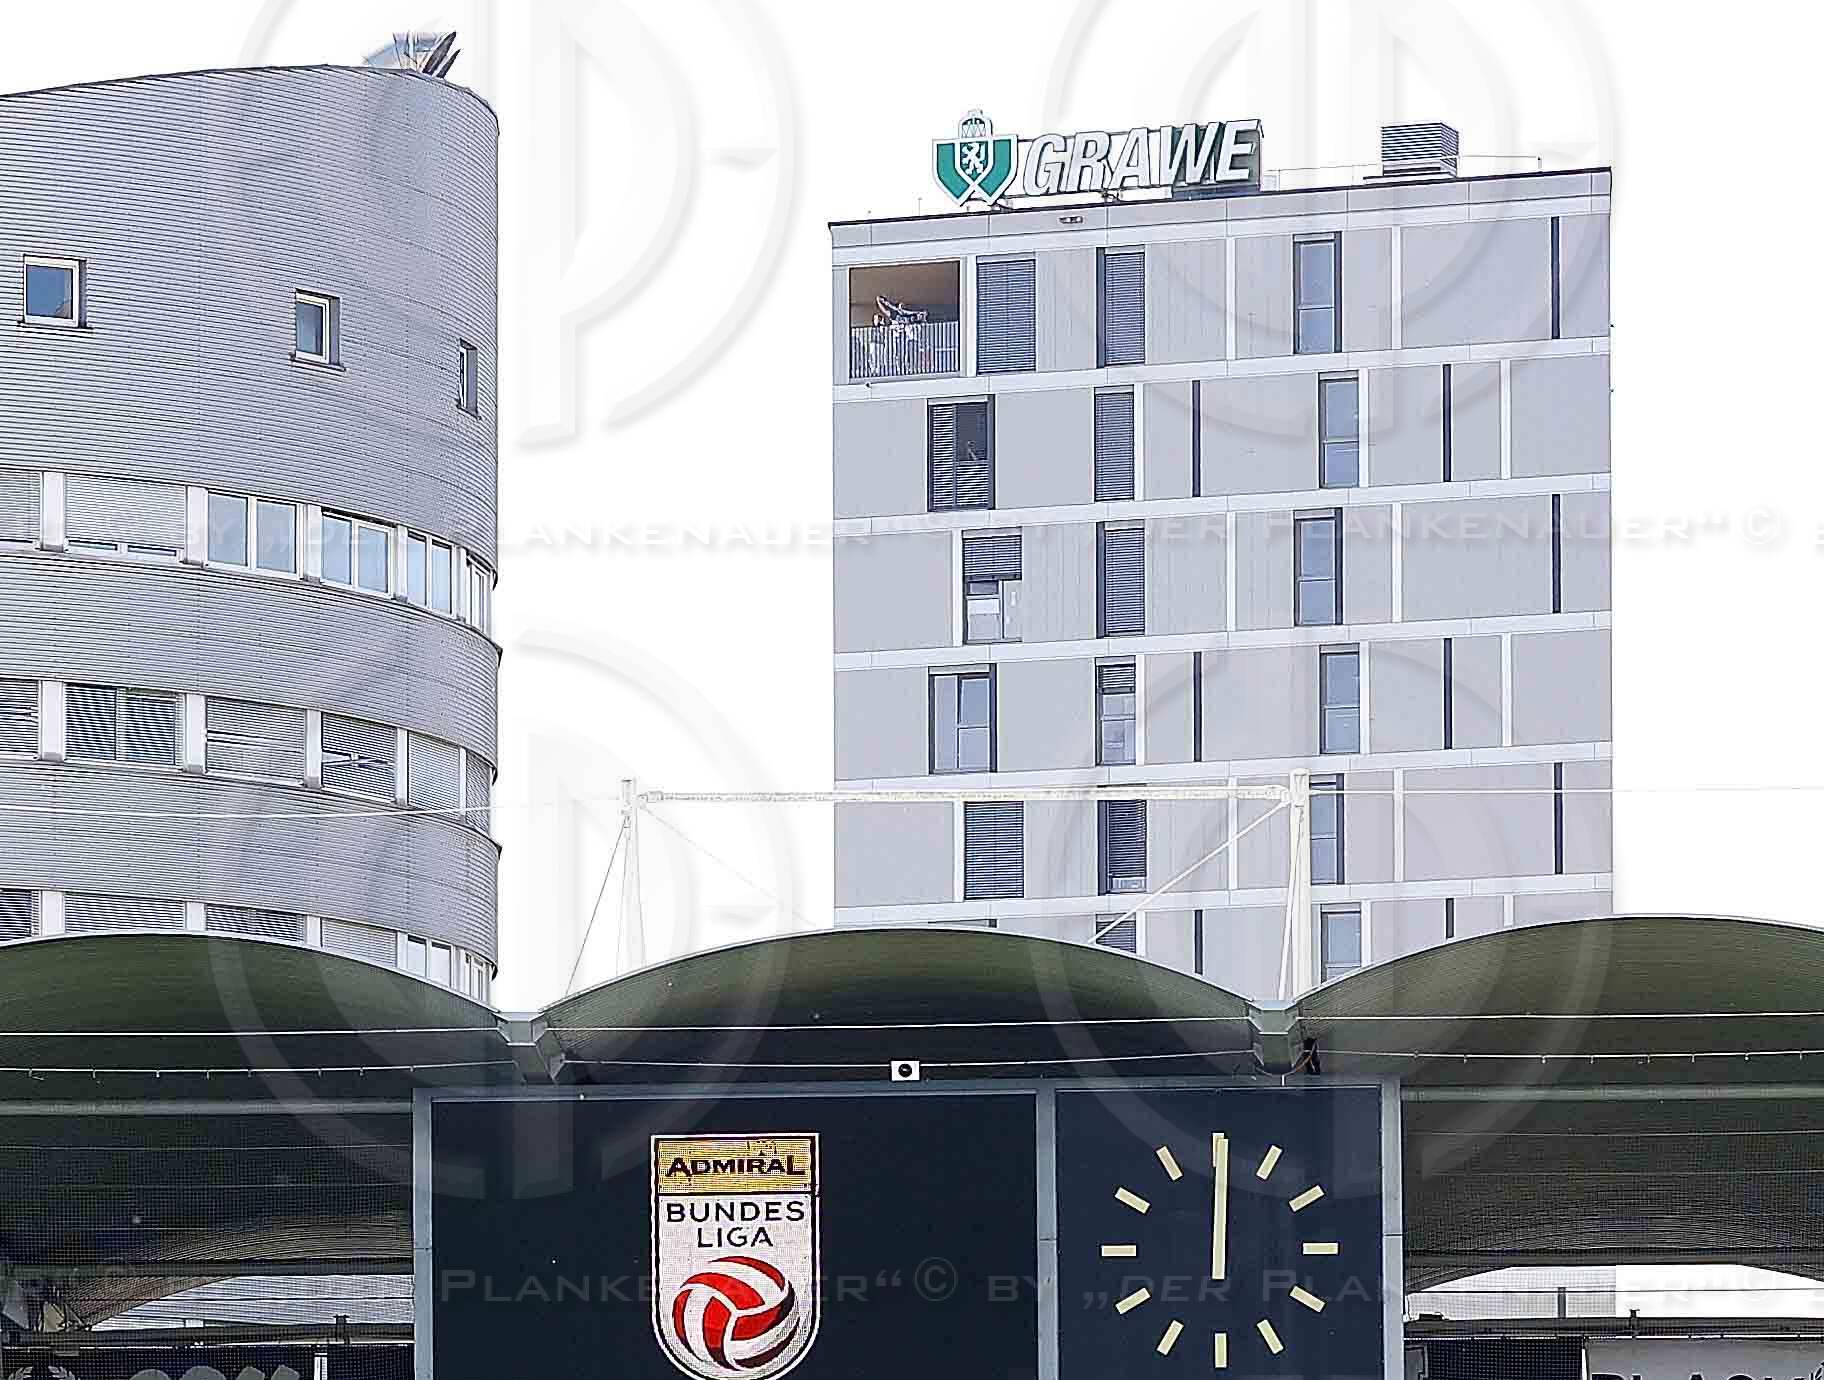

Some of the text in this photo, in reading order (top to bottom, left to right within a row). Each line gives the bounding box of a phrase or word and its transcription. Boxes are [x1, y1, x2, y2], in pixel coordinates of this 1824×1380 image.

[1023, 119, 1261, 198] GRAWE
[665, 1154, 806, 1179] ADMIRAL
[666, 1200, 806, 1223] BUNDES
[696, 1226, 774, 1248] LIGA
